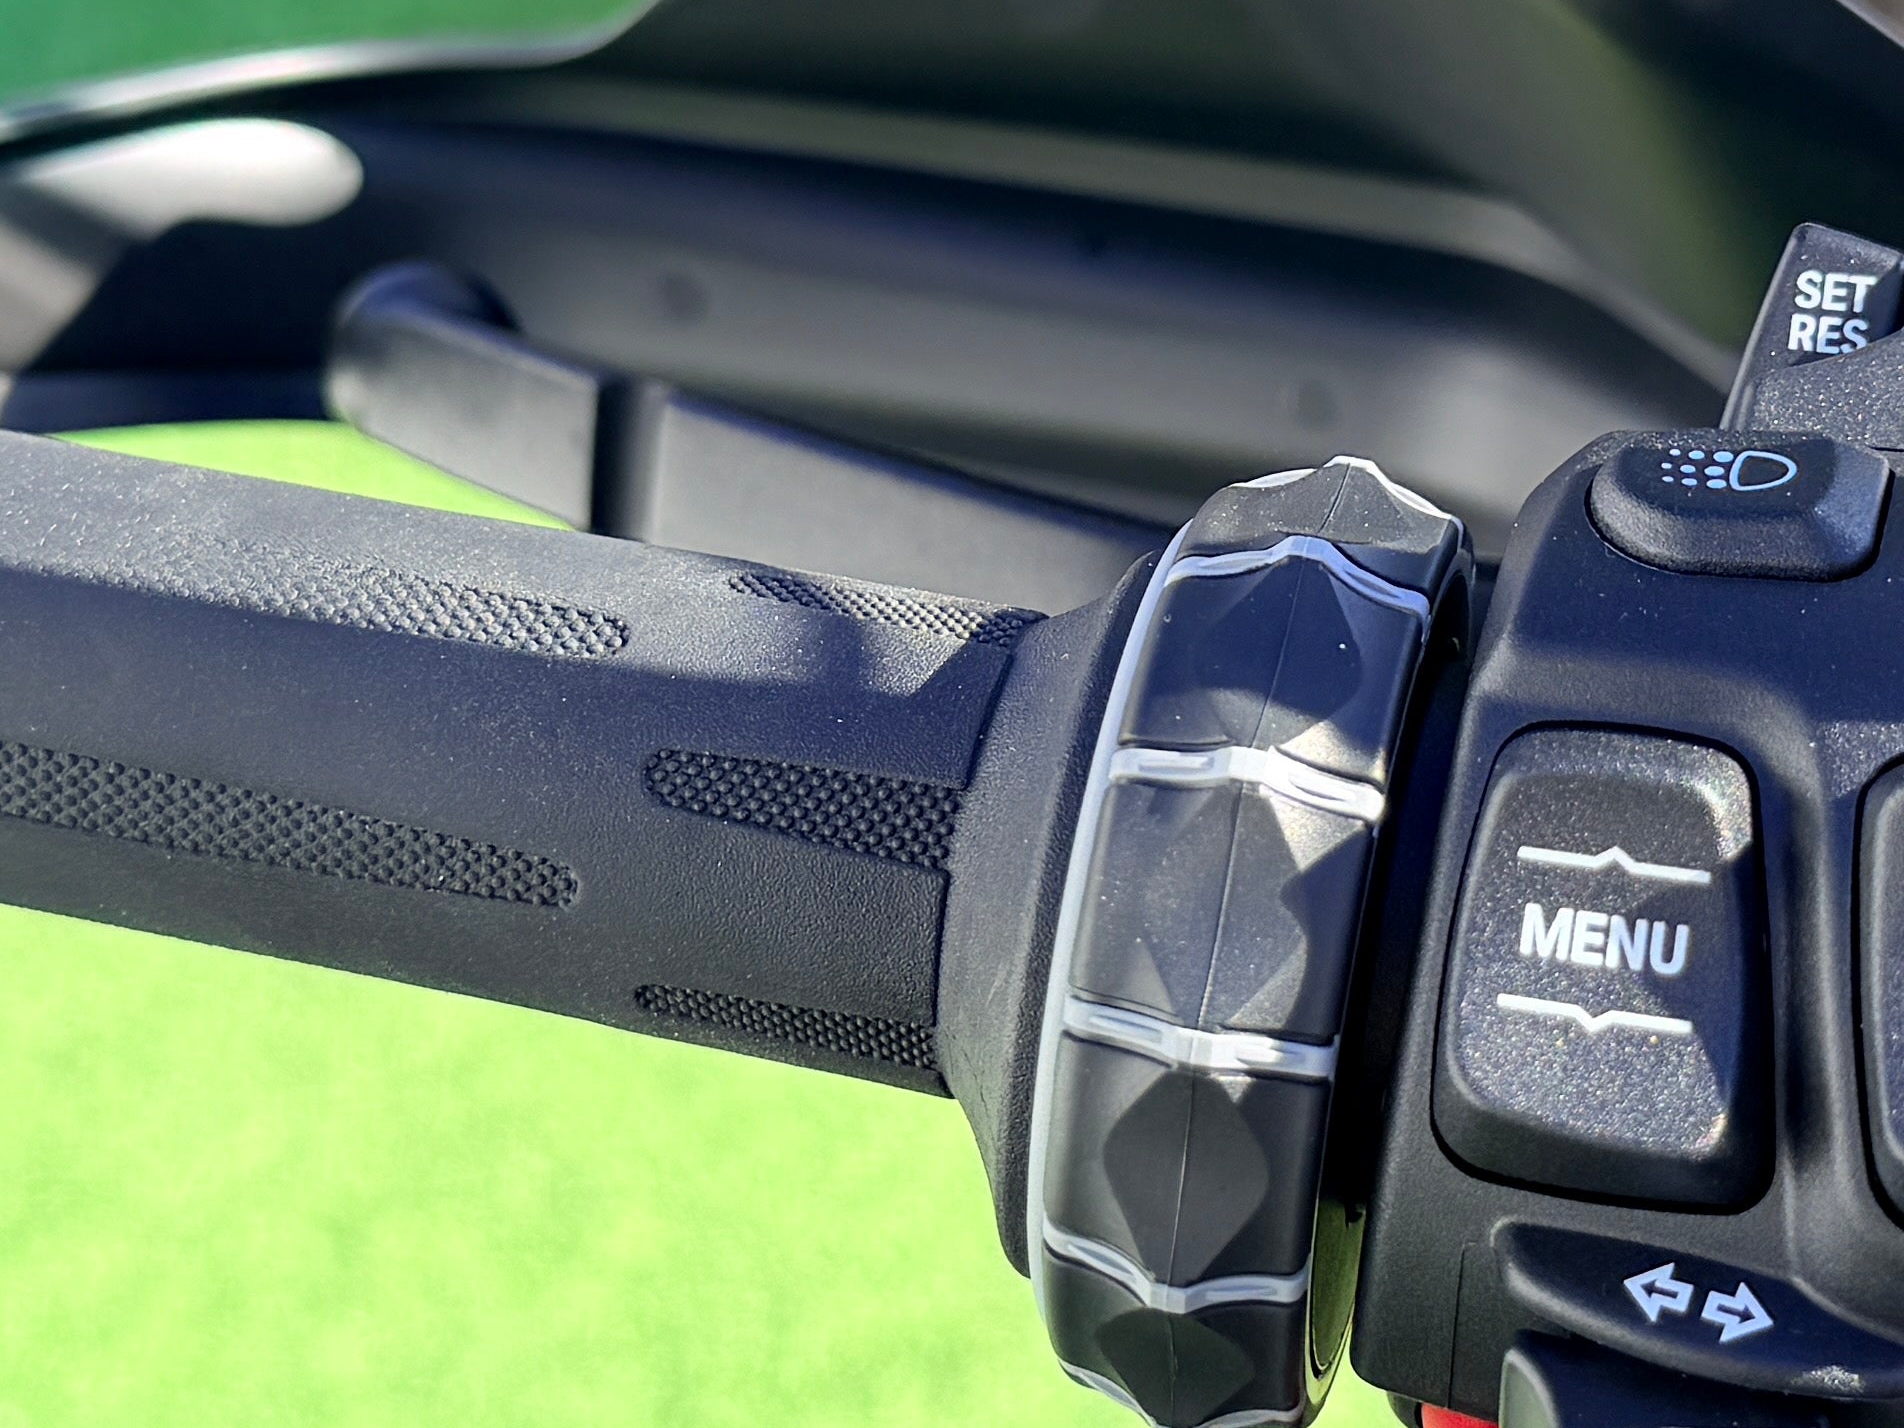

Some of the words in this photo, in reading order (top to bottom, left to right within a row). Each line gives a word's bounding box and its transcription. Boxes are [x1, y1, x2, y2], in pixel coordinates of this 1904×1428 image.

[1795, 269, 1879, 313] SET
[1786, 314, 1870, 356] RES
[1518, 902, 1689, 974] MENU
